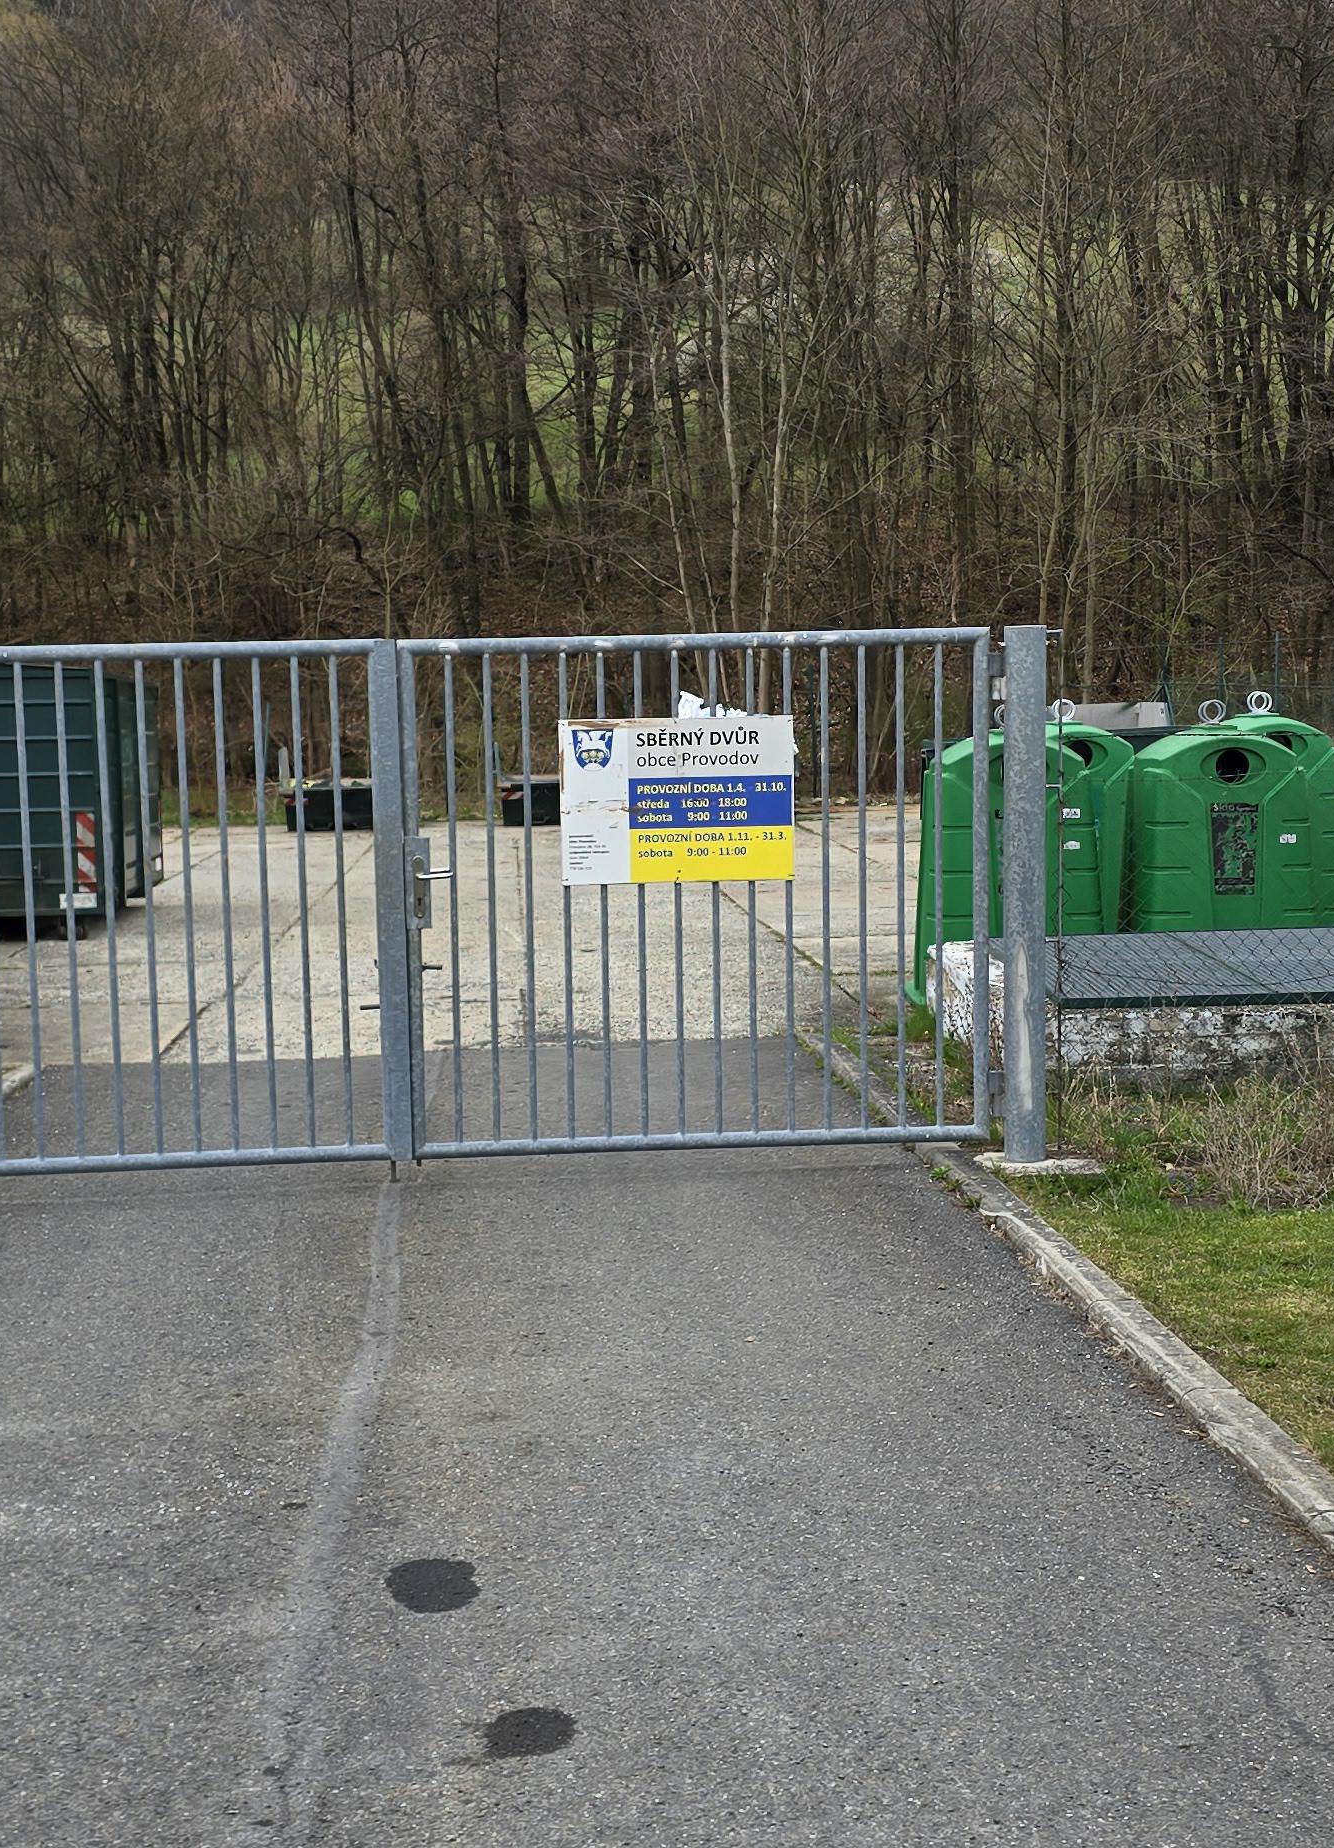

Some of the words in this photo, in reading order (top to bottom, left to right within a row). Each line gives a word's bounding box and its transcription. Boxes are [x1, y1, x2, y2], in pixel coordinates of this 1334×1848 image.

[636, 728, 704, 747] SBĚRNÝ
[710, 726, 759, 746] DVŮR
[637, 752, 676, 767] obce
[682, 751, 759, 767] Provodov
[637, 782, 691, 795] PROVOZNÍ
[693, 784, 725, 793] DOBA
[727, 783, 746, 793] 1.4.
[754, 782, 787, 792] 31.10.
[637, 799, 670, 809] středa
[680, 798, 709, 809] 16:00
[718, 797, 747, 807] 18:00
[637, 813, 673, 823] sobota
[687, 812, 710, 821] 9:00
[719, 811, 747, 821] 11:00
[638, 831, 692, 843] PROVOZNÍ
[695, 832, 725, 842] DOBA
[728, 832, 753, 841] 1.11.
[762, 831, 787, 841] 31.3.
[638, 848, 673, 858] sobota
[687, 847, 709, 857] 9:00
[719, 846, 747, 856] 11:00
